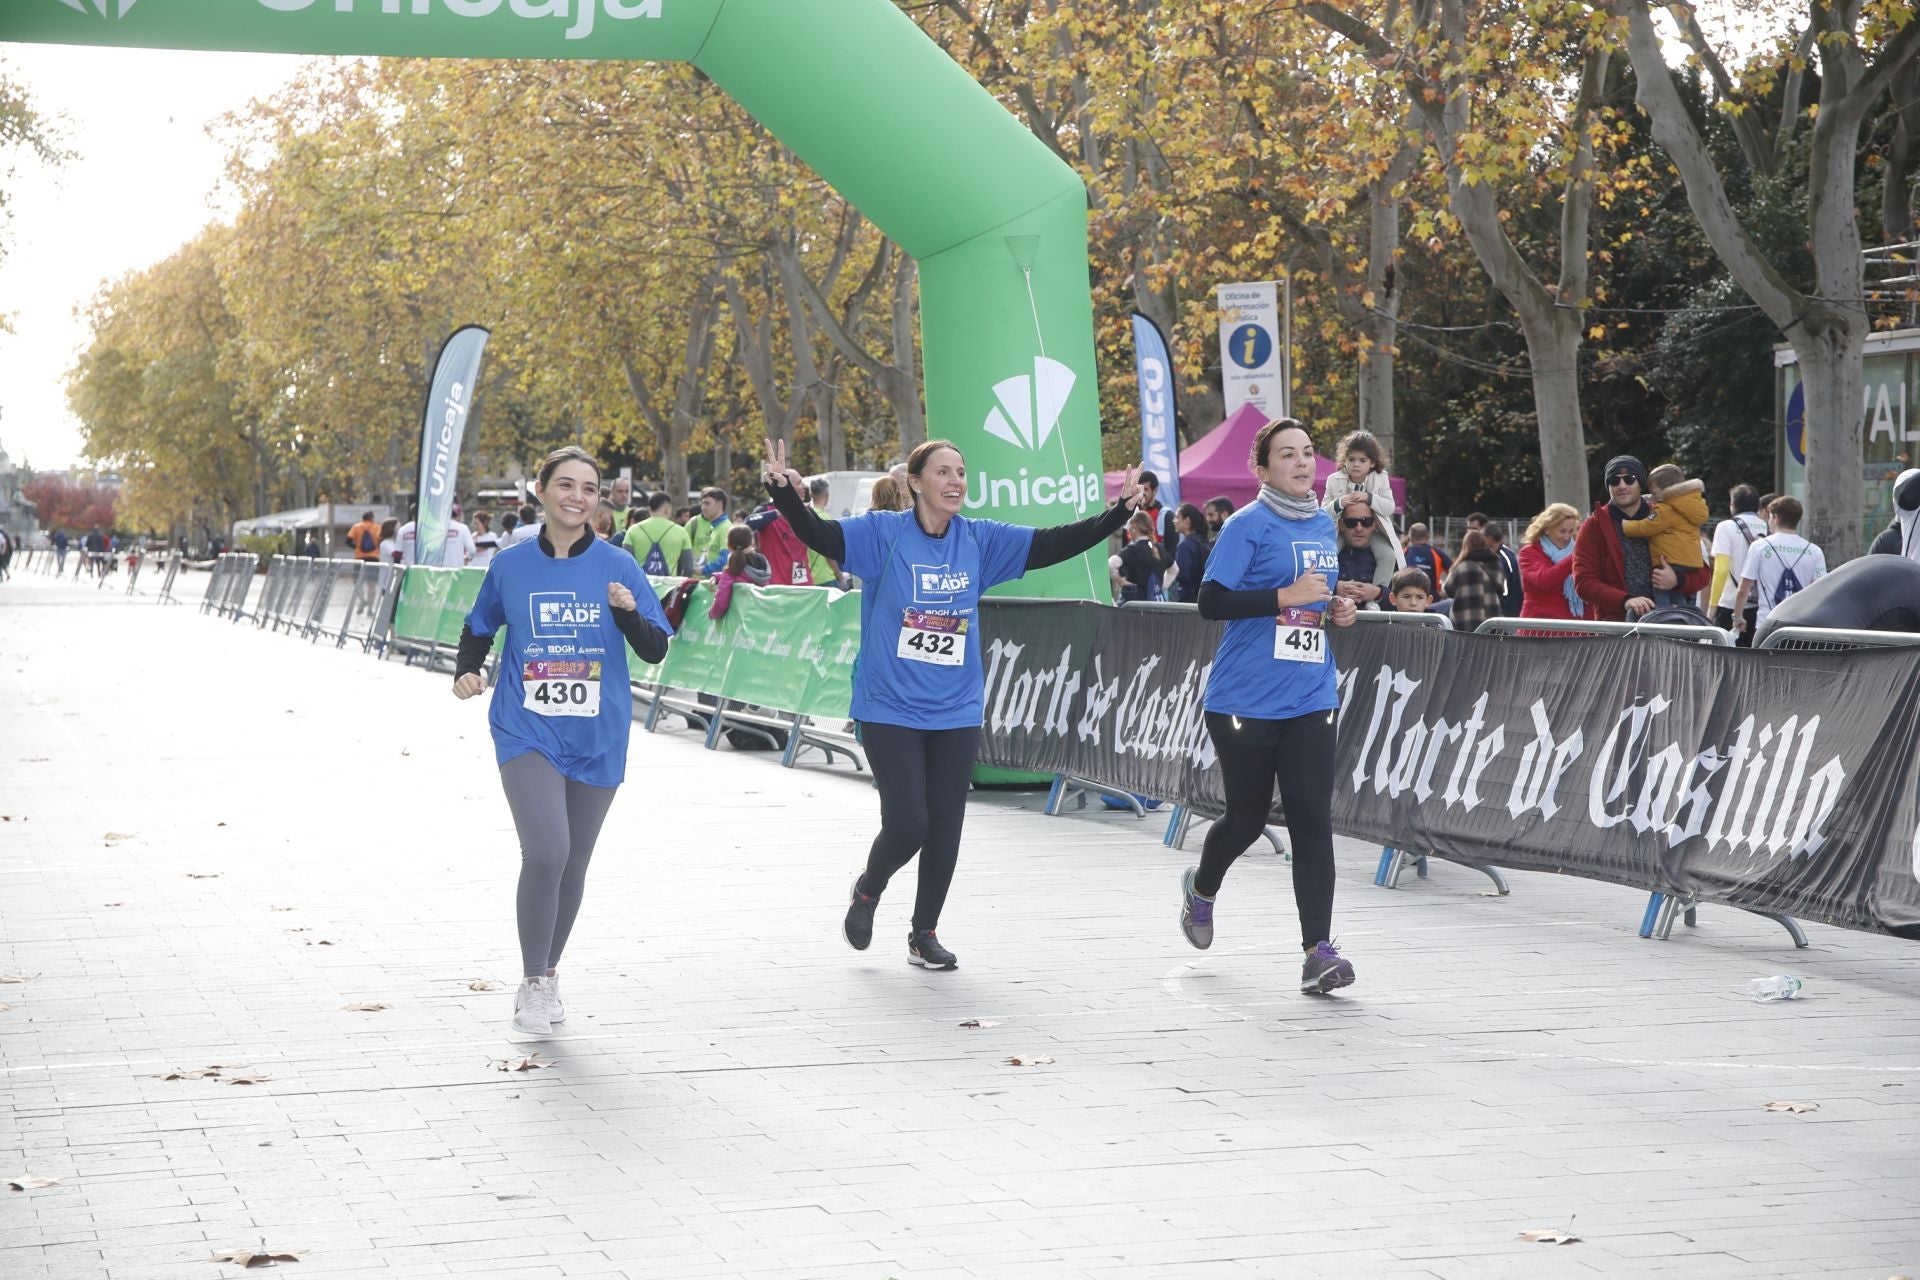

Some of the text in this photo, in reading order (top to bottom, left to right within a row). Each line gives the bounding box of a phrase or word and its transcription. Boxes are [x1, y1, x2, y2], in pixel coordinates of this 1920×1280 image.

[1225, 291, 1261, 300] Oficina de
[1144, 357, 1171, 484] IVECO
[431, 382, 464, 496] Unicaja
[963, 464, 1100, 514] Unicaja
[940, 577, 970, 590] ADF
[561, 609, 600, 623] ADF
[555, 645, 575, 653] DGH
[907, 632, 955, 655] 432
[1285, 629, 1319, 652] 431
[534, 682, 587, 705] 430
[983, 639, 1080, 738] Norte
[1352, 664, 1505, 814] Norte
[1506, 698, 1584, 822] de
[1589, 692, 1846, 863] Castilla
